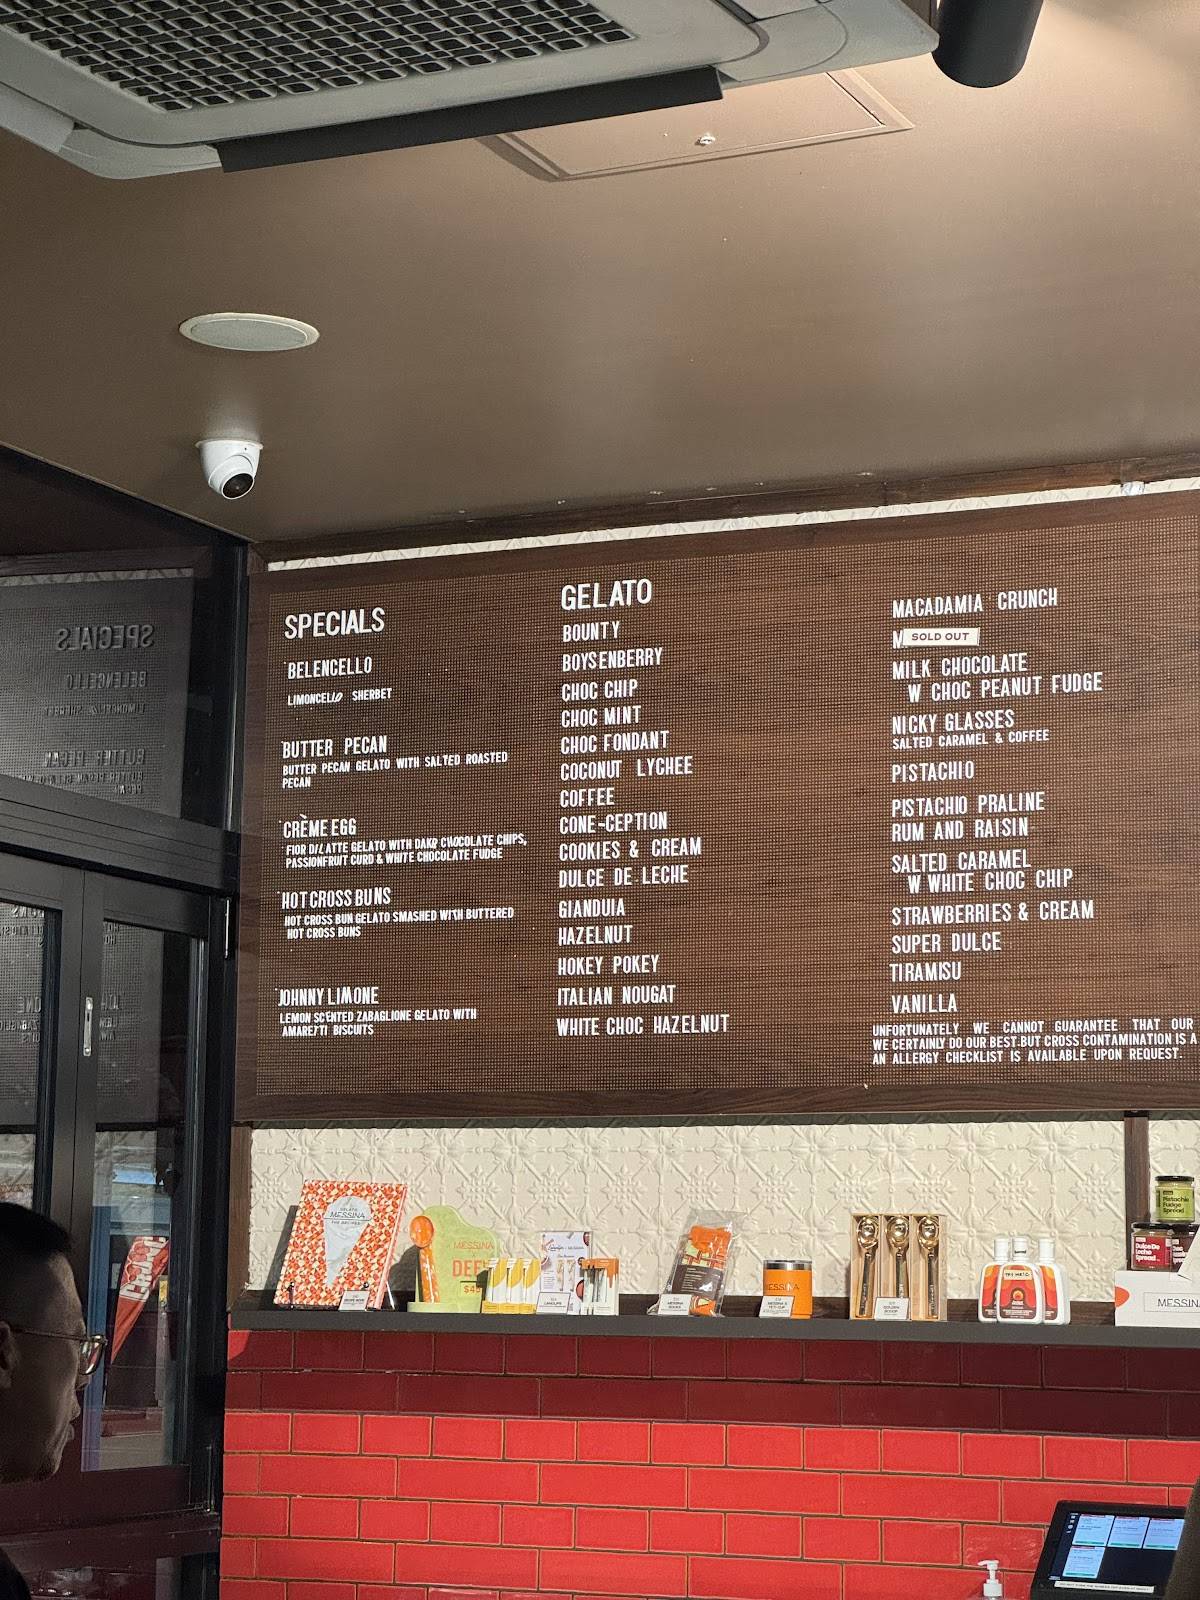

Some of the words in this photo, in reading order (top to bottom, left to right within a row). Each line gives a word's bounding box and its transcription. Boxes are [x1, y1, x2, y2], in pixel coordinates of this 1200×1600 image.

[562, 578, 652, 610] GELATO
[892, 594, 984, 618] MACADAMIA
[998, 588, 1058, 610] CRUNCH
[284, 608, 386, 638] SPECIALS
[562, 620, 620, 642] BOUNTY
[911, 633, 942, 641] SOLD
[945, 632, 969, 641] OUT
[288, 656, 372, 680] BELENCELLO
[562, 646, 662, 672] BOYSENBERRY
[892, 658, 932, 680] MILK
[942, 652, 1028, 676] CHOCOLATE
[352, 688, 392, 702] SHERBET
[562, 682, 598, 702] CHOC
[604, 678, 638, 698] CHIP
[908, 684, 922, 702] W
[932, 680, 970, 702] CHOC
[982, 676, 1042, 698] PEANUT
[1052, 672, 1104, 694] FUDGE
[562, 708, 598, 728] CHOC
[604, 704, 642, 726] MINT
[892, 714, 938, 736] NICKY
[944, 708, 1016, 731] GLASSES
[282, 738, 334, 758] BUTTER
[344, 736, 386, 754] PECAN
[560, 734, 598, 754] CHOC
[604, 730, 670, 752] FONDANT
[892, 736, 932, 750] SALTED
[938, 732, 988, 748] CARAMEL
[994, 732, 1004, 744] &
[1008, 728, 1050, 742] COFFEE
[282, 764, 316, 776] BUTTER
[322, 762, 350, 774] PECAN
[356, 758, 390, 772] GELATO
[396, 756, 420, 768] WITH
[424, 754, 460, 768] SALTED
[466, 752, 508, 764] ROASTED
[560, 760, 622, 780] COCONUT
[638, 756, 692, 776] LYCHEE
[892, 760, 974, 784] PISTACHIO
[282, 776, 310, 788] PECAN
[560, 788, 614, 808] COFFEE
[892, 796, 968, 818] PISTACHIO
[978, 792, 1044, 814] PRALINE
[332, 818, 356, 836] EGG
[560, 812, 668, 834] CONE-CEPTION
[892, 822, 924, 842] RUM
[934, 820, 964, 840] AND
[974, 816, 1028, 838] RAISIN
[286, 844, 306, 856] FIOR
[350, 840, 386, 852] GELATO
[388, 838, 412, 850] WITH
[286, 854, 348, 868] PASSIONFRUIT
[350, 854, 374, 866] CURD
[376, 854, 384, 864] &
[386, 852, 414, 864] WHITE
[416, 849, 470, 862] CHOCOLATE
[472, 848, 502, 860] FUDGE
[560, 840, 620, 862] COOKIES
[630, 840, 638, 858] &
[652, 836, 702, 856] CREAM
[892, 852, 948, 874] SALTED
[958, 848, 1032, 870] CARAMEL
[558, 868, 604, 888] DULCE
[614, 866, 632, 886] DE
[642, 864, 688, 884] LECHE
[908, 874, 922, 894] W
[928, 870, 974, 894] WHITE
[984, 870, 1024, 890] CHOC
[1036, 868, 1074, 888] CHIP
[282, 892, 308, 910] HOT
[310, 890, 352, 908] CROSS
[354, 886, 390, 906] BUNS
[558, 898, 626, 918] GIANDUIA
[284, 916, 302, 926] HOT
[304, 914, 334, 926] CROSS
[334, 912, 354, 924] BUN
[356, 912, 390, 924] GELATO
[392, 910, 436, 922] SMASHED
[440, 908, 464, 920] WITH
[466, 906, 514, 920] BUTTERED
[892, 902, 1012, 926] STRAWBERRIES
[1018, 902, 1028, 920] &
[1040, 900, 1094, 920] CREAM
[288, 928, 304, 940] HOT
[306, 926, 336, 938] CROSS
[338, 926, 362, 938] BUNS
[558, 924, 632, 946] HAZELNUT
[892, 934, 942, 954] SUPER
[952, 932, 1002, 952] DULCE
[558, 956, 604, 976] HOKEY
[612, 954, 660, 974] POKEY
[890, 962, 962, 982] TIRAMISU
[278, 988, 324, 1006] JOHNNY
[328, 986, 378, 1006] LIMONE
[558, 986, 612, 1006] ITALIAN
[622, 984, 676, 1004] NOUGAT
[892, 994, 958, 1014] VANILLA
[280, 1012, 312, 1024] LEMON
[314, 1010, 354, 1024] SCENTED
[356, 1010, 412, 1022] ZABAGLIONE
[414, 1008, 450, 1020] GELATO
[452, 1008, 476, 1020] WITH
[556, 1018, 600, 1036] WHITE
[606, 1016, 644, 1036] CHOC
[654, 1014, 730, 1034] HAZELNUT
[872, 1022, 960, 1036] UNFORTUNATELY
[972, 1022, 990, 1034] WE
[1002, 1020, 1044, 1034] CANNOT
[1054, 1020, 1118, 1032] GUARANTEE
[1132, 1018, 1160, 1030] THAT
[1172, 1018, 1194, 1030] OUR
[332, 1024, 374, 1036] BISCUITS
[872, 1038, 888, 1050] WE
[892, 1038, 946, 1050] CERTAINLY
[948, 1036, 962, 1050] DO
[966, 1036, 986, 1048] OUR
[1044, 1034, 1080, 1048] CROSS
[1082, 1032, 1172, 1046] CONTAMINATION
[1176, 1032, 1186, 1044] IS
[872, 1052, 886, 1064] AN
[892, 1052, 938, 1064] ALLERGY
[946, 1050, 1004, 1064] CHECKLIST
[1010, 1050, 1020, 1062] IS
[1028, 1048, 1086, 1062] AVAILABLE
[1094, 1048, 1122, 1060] UPON
[1130, 1046, 1183, 1060] REQUEST.
[453, 1240, 495, 1249] MESSINA
